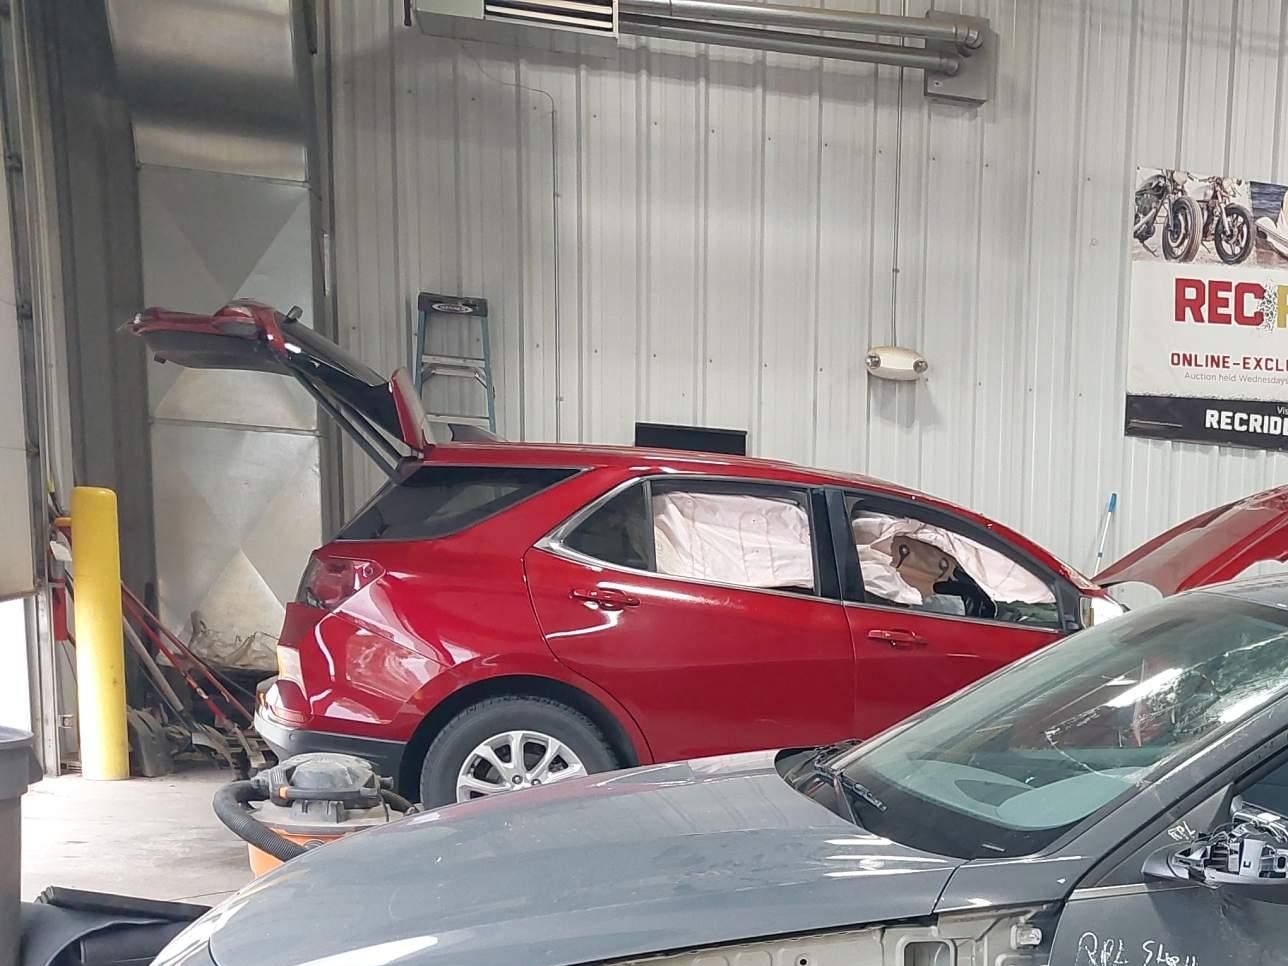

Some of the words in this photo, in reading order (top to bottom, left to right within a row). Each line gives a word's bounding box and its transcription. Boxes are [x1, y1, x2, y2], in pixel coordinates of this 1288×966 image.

[1184, 372, 1217, 381] Auction
[1218, 373, 1236, 382] held
[1239, 374, 1288, 386] Wednesdays
